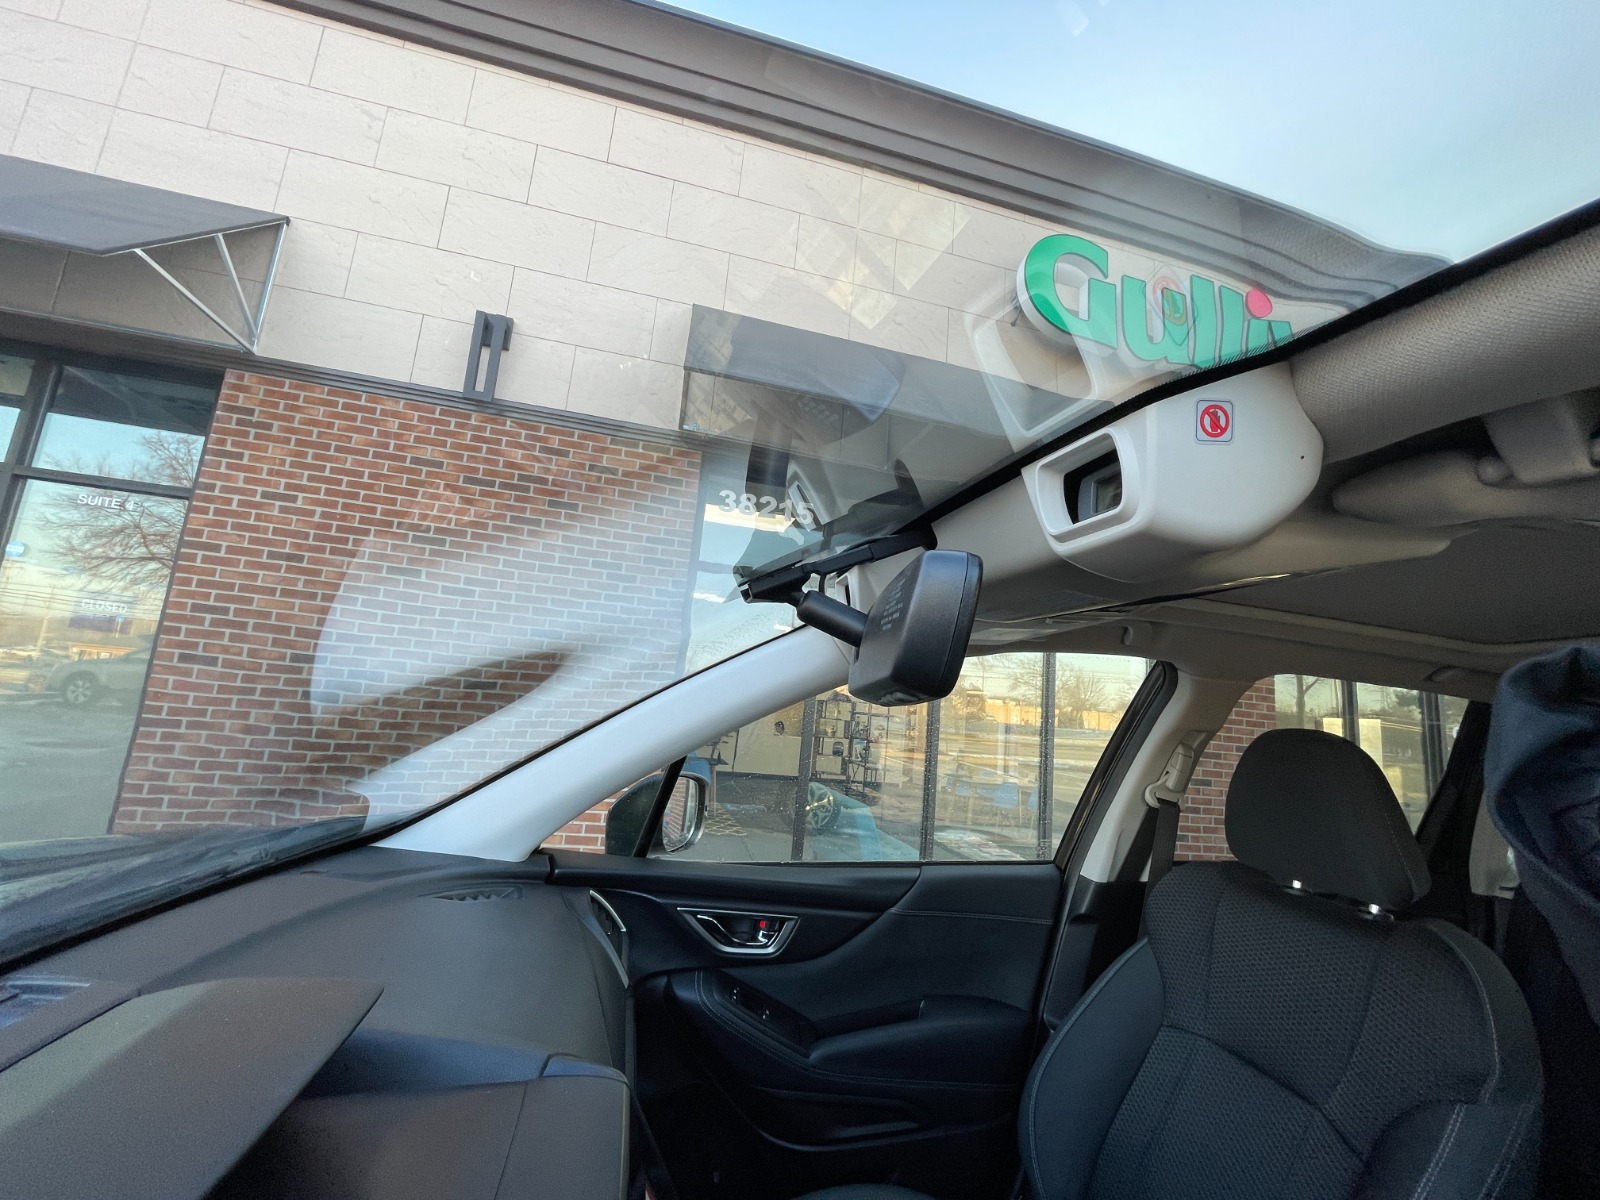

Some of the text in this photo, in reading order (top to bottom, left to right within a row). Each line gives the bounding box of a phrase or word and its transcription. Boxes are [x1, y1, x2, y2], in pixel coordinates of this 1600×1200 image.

[1018, 234, 1293, 366] Gulli
[77, 494, 121, 509] SUITE
[718, 489, 814, 525] 38215
[81, 599, 128, 613] CLOSED
